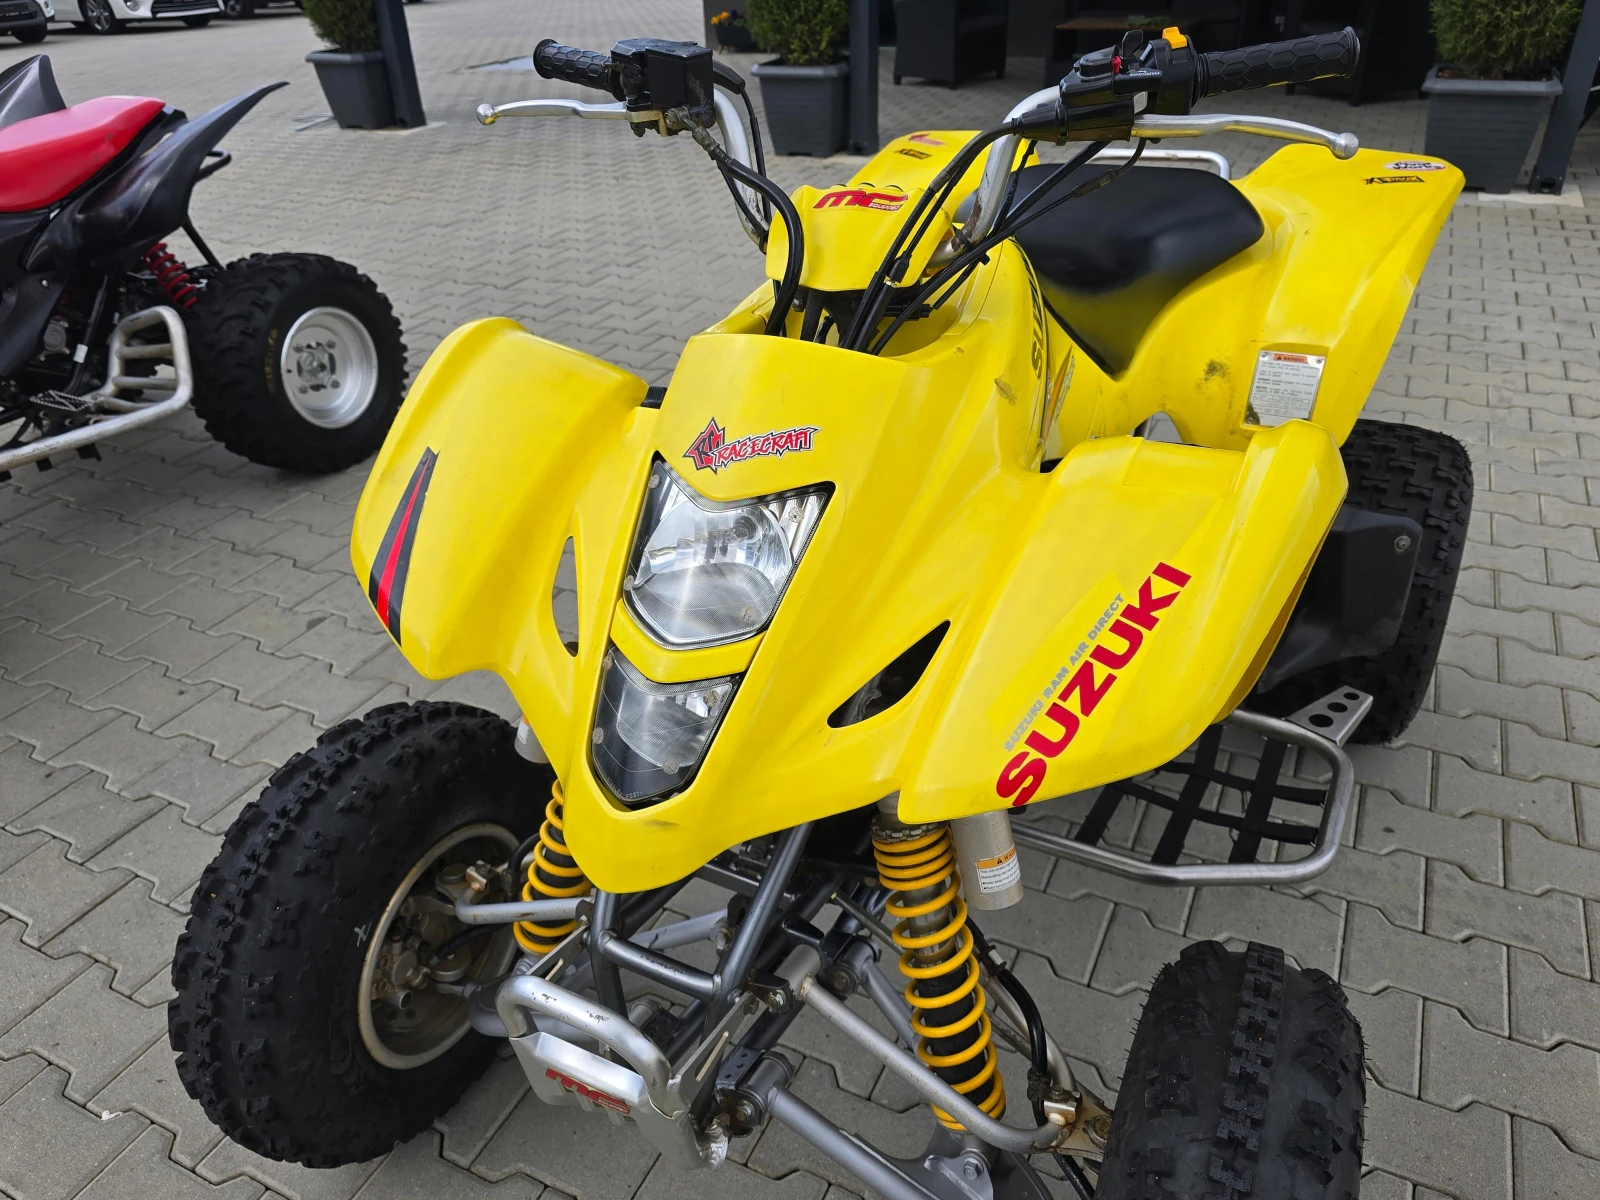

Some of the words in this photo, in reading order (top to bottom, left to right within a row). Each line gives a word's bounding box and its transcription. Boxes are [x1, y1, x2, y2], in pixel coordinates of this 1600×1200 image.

[712, 427, 820, 468] RACECRAFT
[996, 561, 1192, 807] SUZUKI
[1004, 699, 1044, 753] SUZUKI
[1042, 666, 1070, 700] RAM
[1069, 641, 1090, 667] AIR
[1087, 593, 1125, 641] DIRECT
